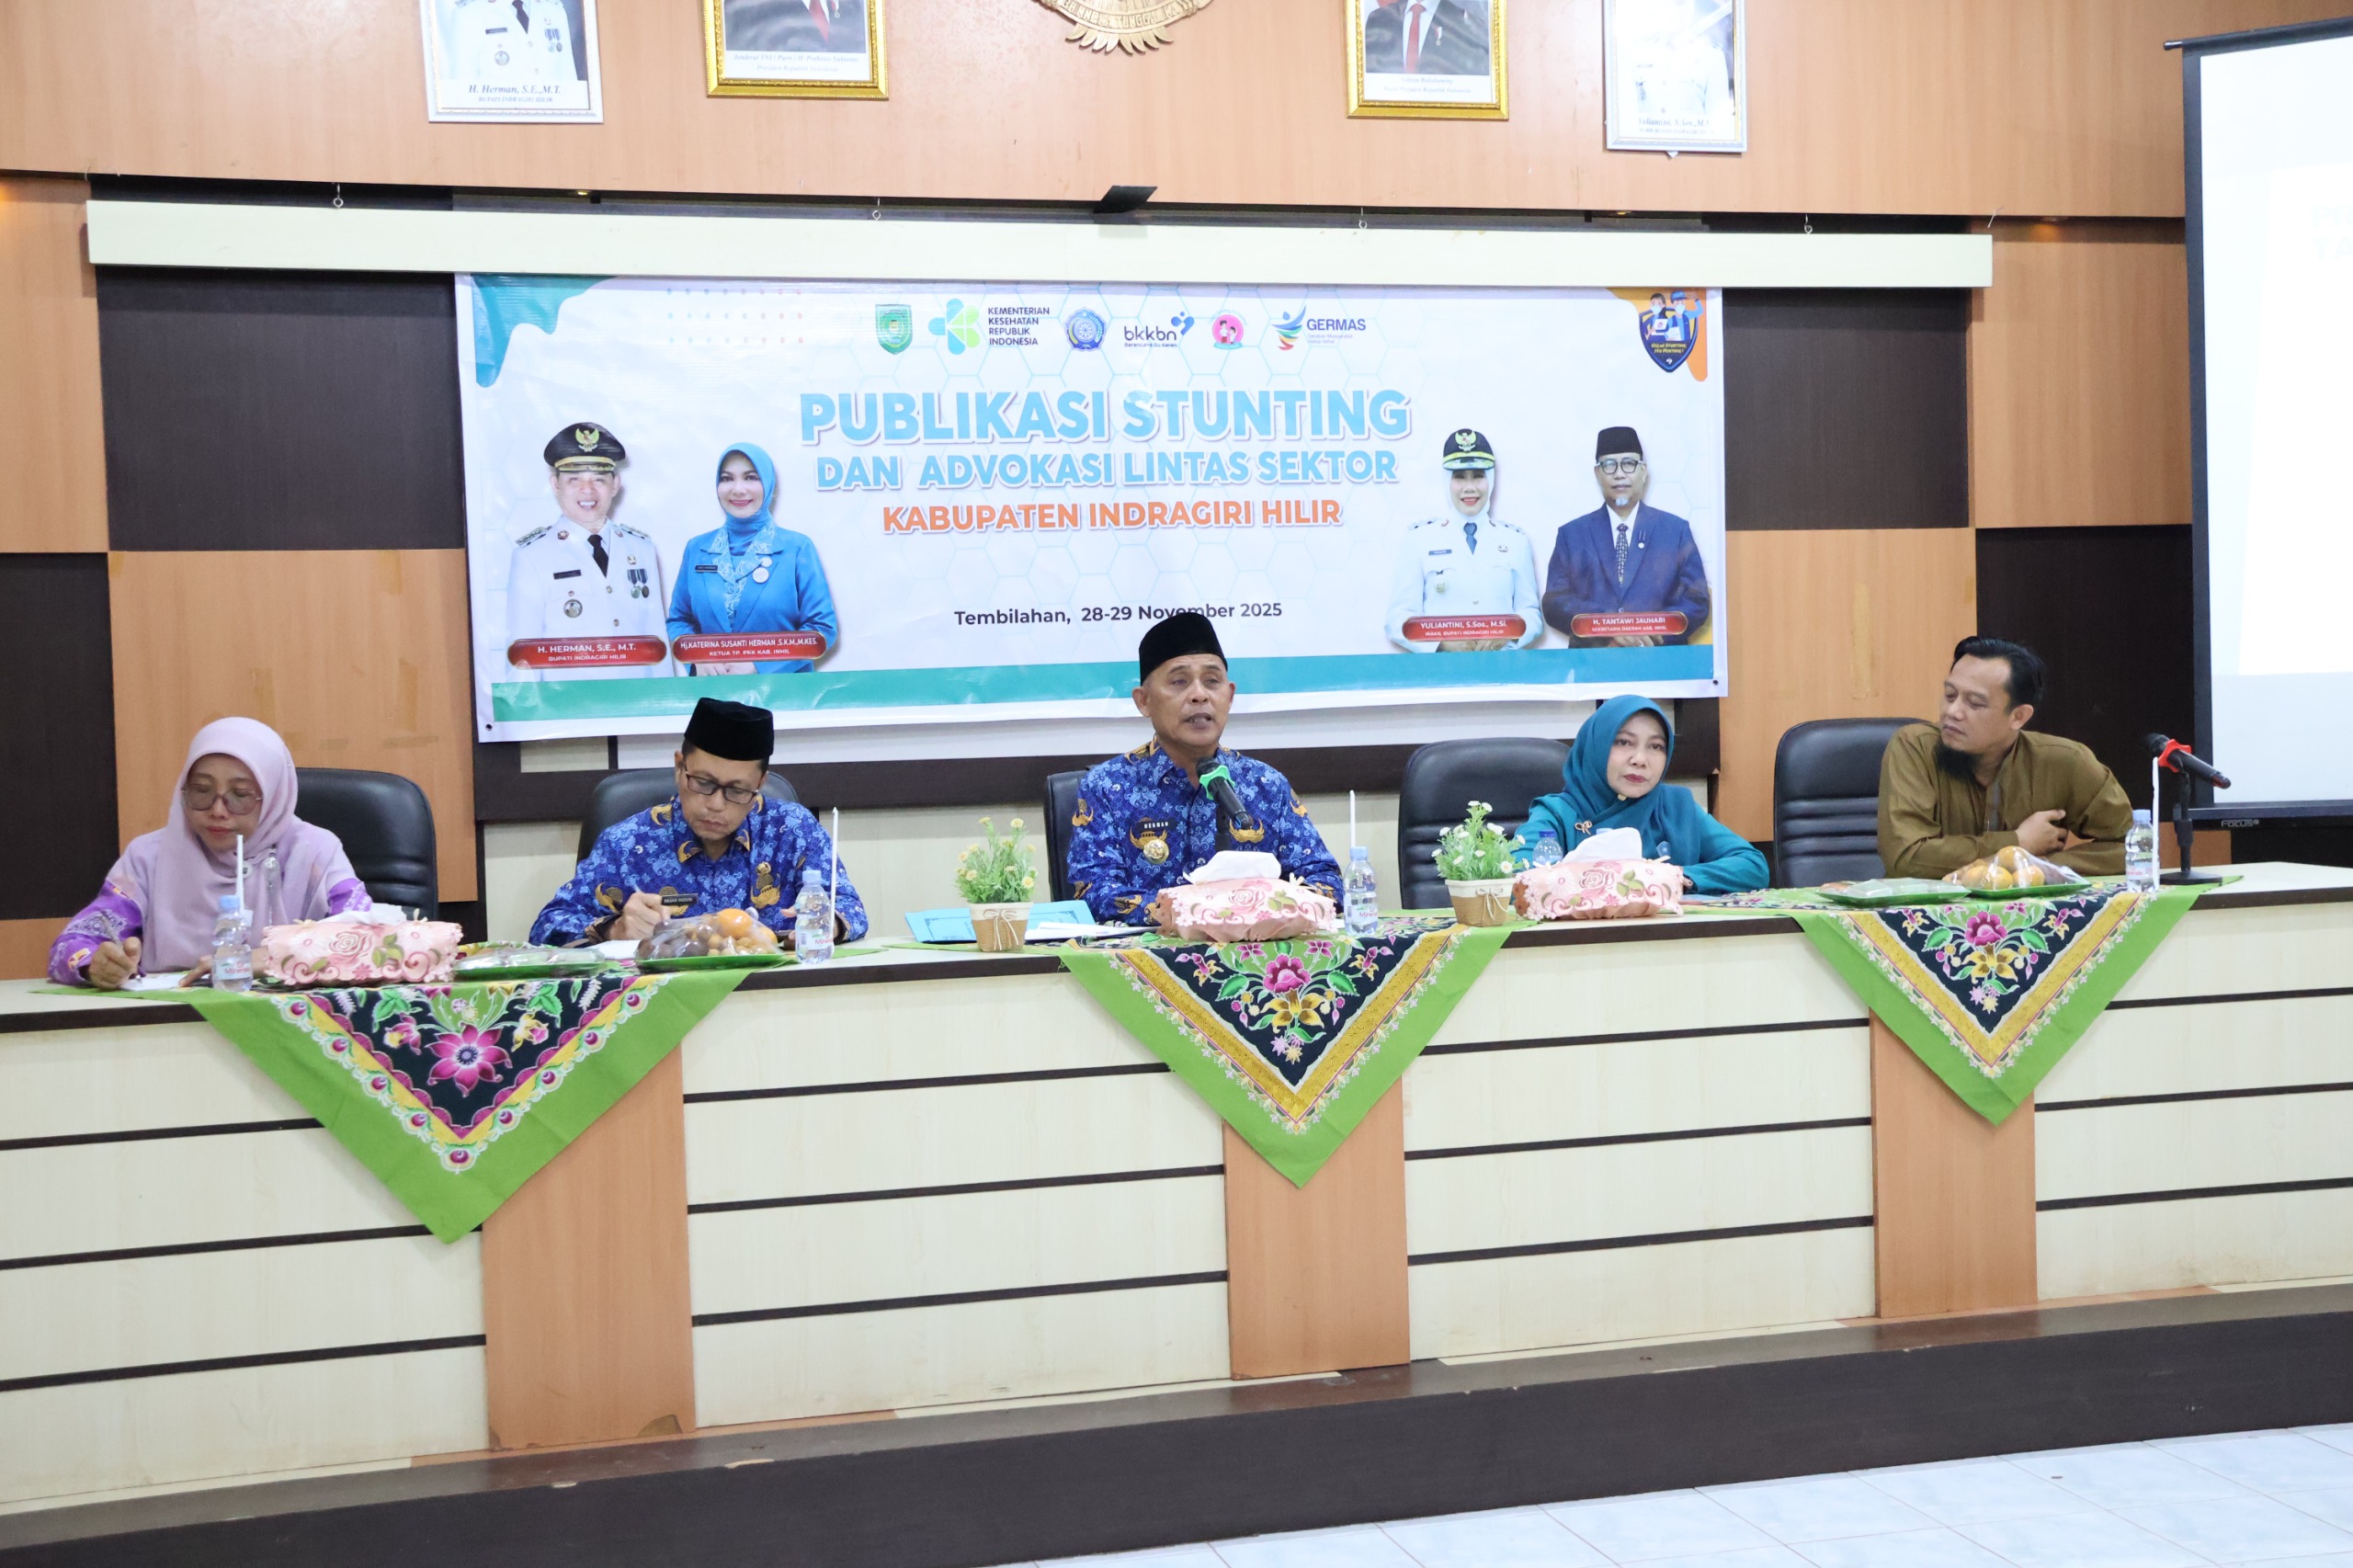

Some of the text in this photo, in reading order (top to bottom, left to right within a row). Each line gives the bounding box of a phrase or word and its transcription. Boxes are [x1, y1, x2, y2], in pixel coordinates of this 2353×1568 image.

[469, 85, 479, 94] H.
[483, 85, 519, 95] Herman,
[988, 307, 1050, 315] KEMENTERIAN
[989, 317, 1040, 325] KESEHATAN
[1306, 318, 1367, 331] GERMAS
[989, 327, 1030, 335] REPUBLIK
[1123, 325, 1177, 341] bkkbn
[989, 337, 1039, 346] INDONESIA
[800, 388, 1410, 443] PUBLIKASI STUNTING
[817, 449, 1397, 488] DAN ADVOKASI LINTAS SEKTOR
[882, 499, 1341, 532] KABUPATEN INDRAGIRI HILIR
[954, 608, 1071, 625] Tembilahan,
[1081, 606, 1132, 621] 28-29
[1240, 602, 1282, 618] 2025
[550, 644, 595, 653] HERMAN,
[597, 643, 616, 653] S.E.,
[619, 642, 636, 651] M.T.
[722, 640, 747, 648] SUSANTI
[1143, 821, 1169, 829] HERMAN
